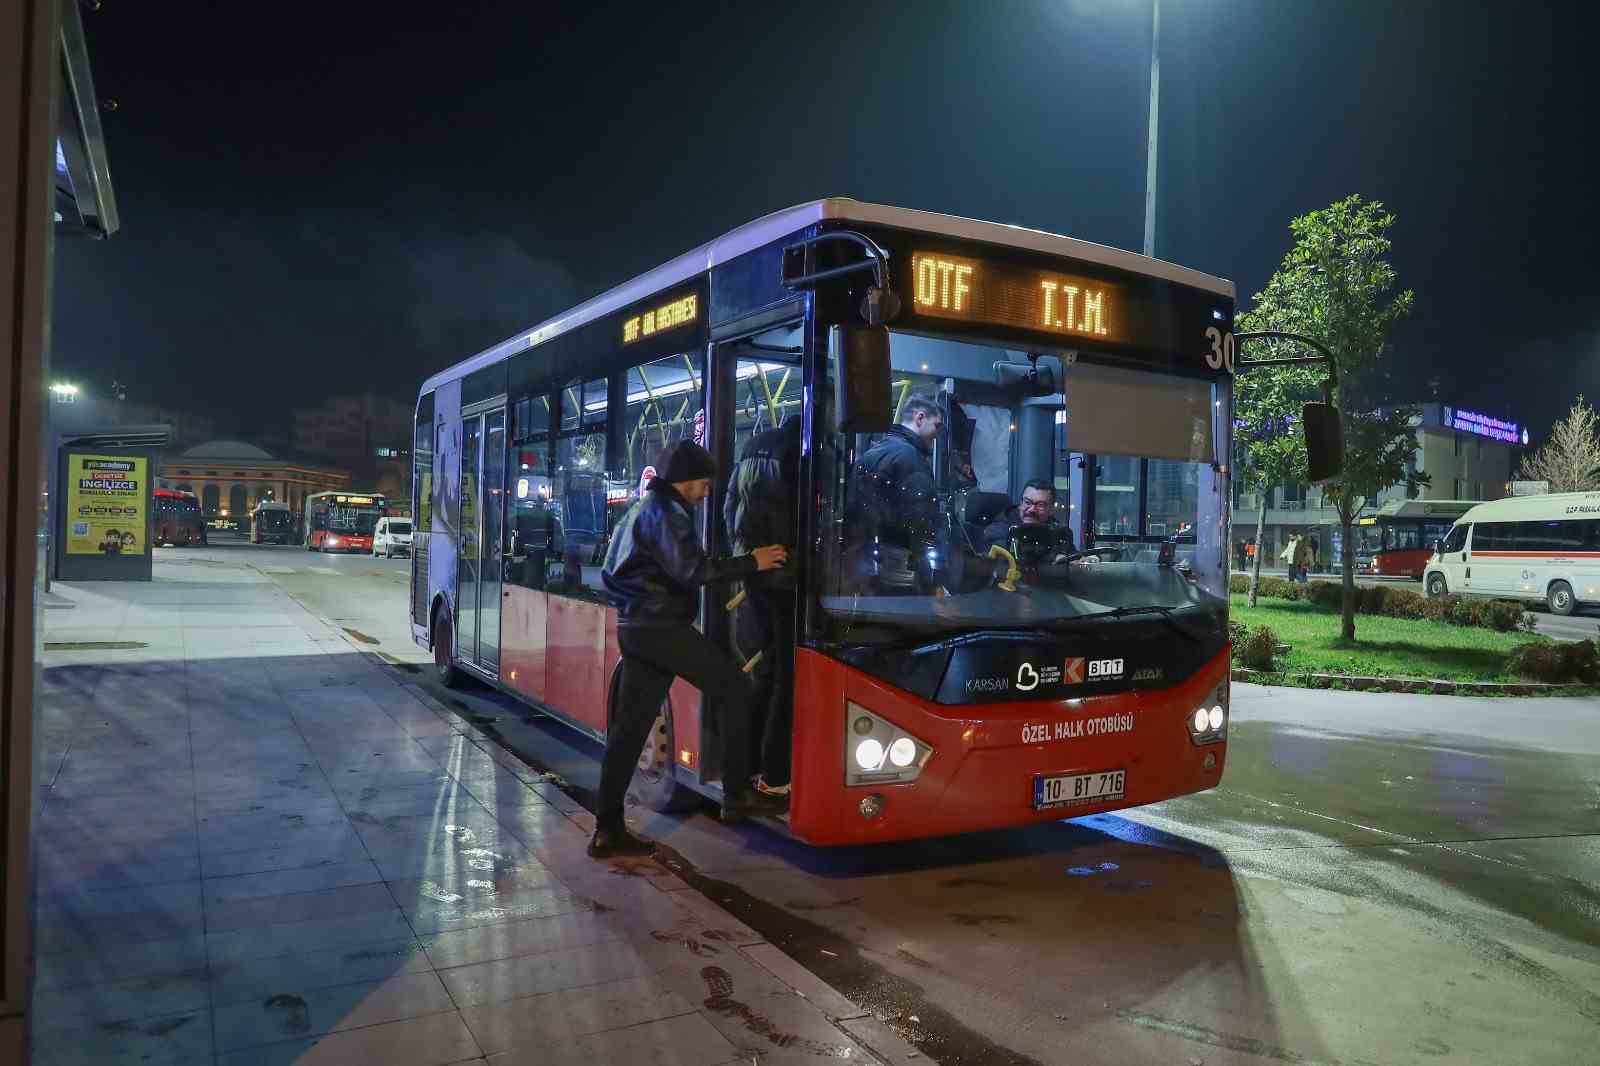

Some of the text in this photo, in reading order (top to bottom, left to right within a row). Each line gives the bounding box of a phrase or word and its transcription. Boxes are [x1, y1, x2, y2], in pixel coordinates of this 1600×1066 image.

[1041, 280, 1107, 335] T.T.M.
[1088, 658, 1124, 677] BTT
[965, 677, 1009, 692] KARSAN
[1021, 710, 1134, 745] ÖZEL HALK OTOBÜSÜ
[1046, 772, 1124, 801] 10 BT 716
